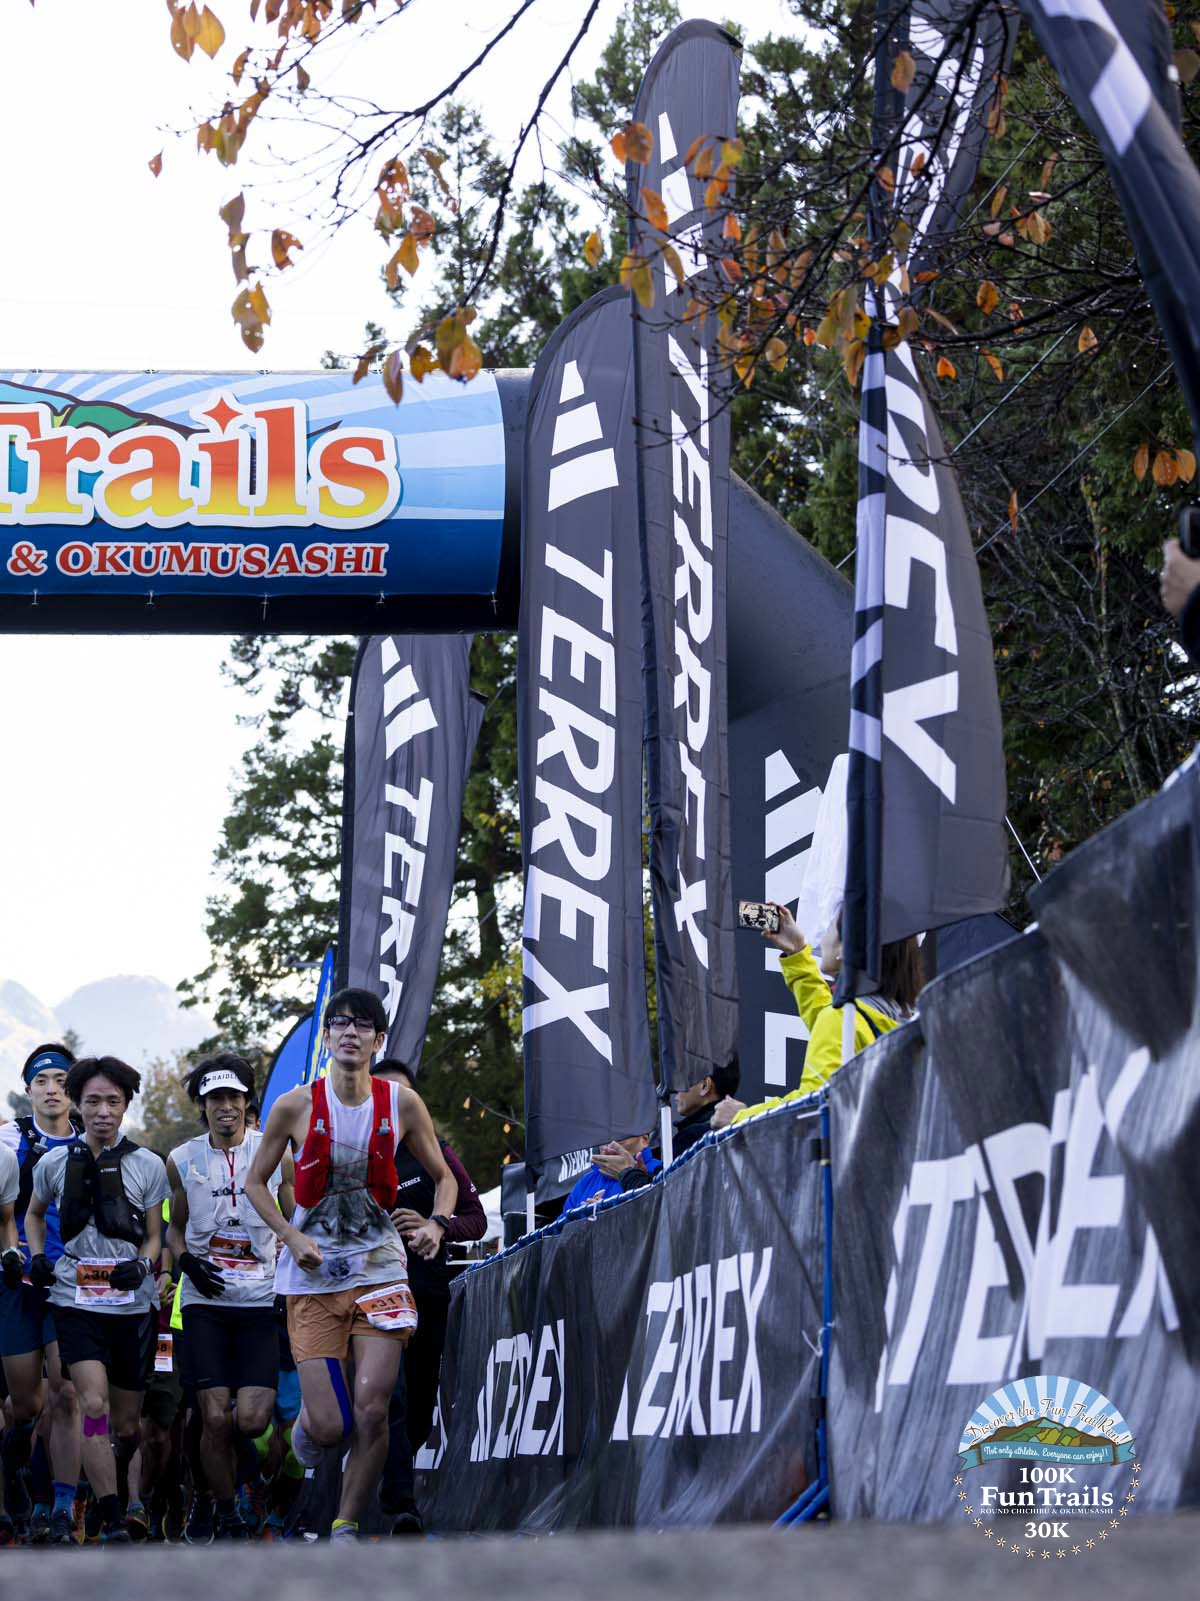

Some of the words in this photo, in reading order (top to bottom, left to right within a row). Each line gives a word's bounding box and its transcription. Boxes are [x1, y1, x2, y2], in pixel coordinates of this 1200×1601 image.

[10, 544, 47, 575] &
[57, 543, 387, 576] OKUMUSASHI
[522, 543, 616, 1066] TERREX
[631, 1246, 773, 1439] TERREX
